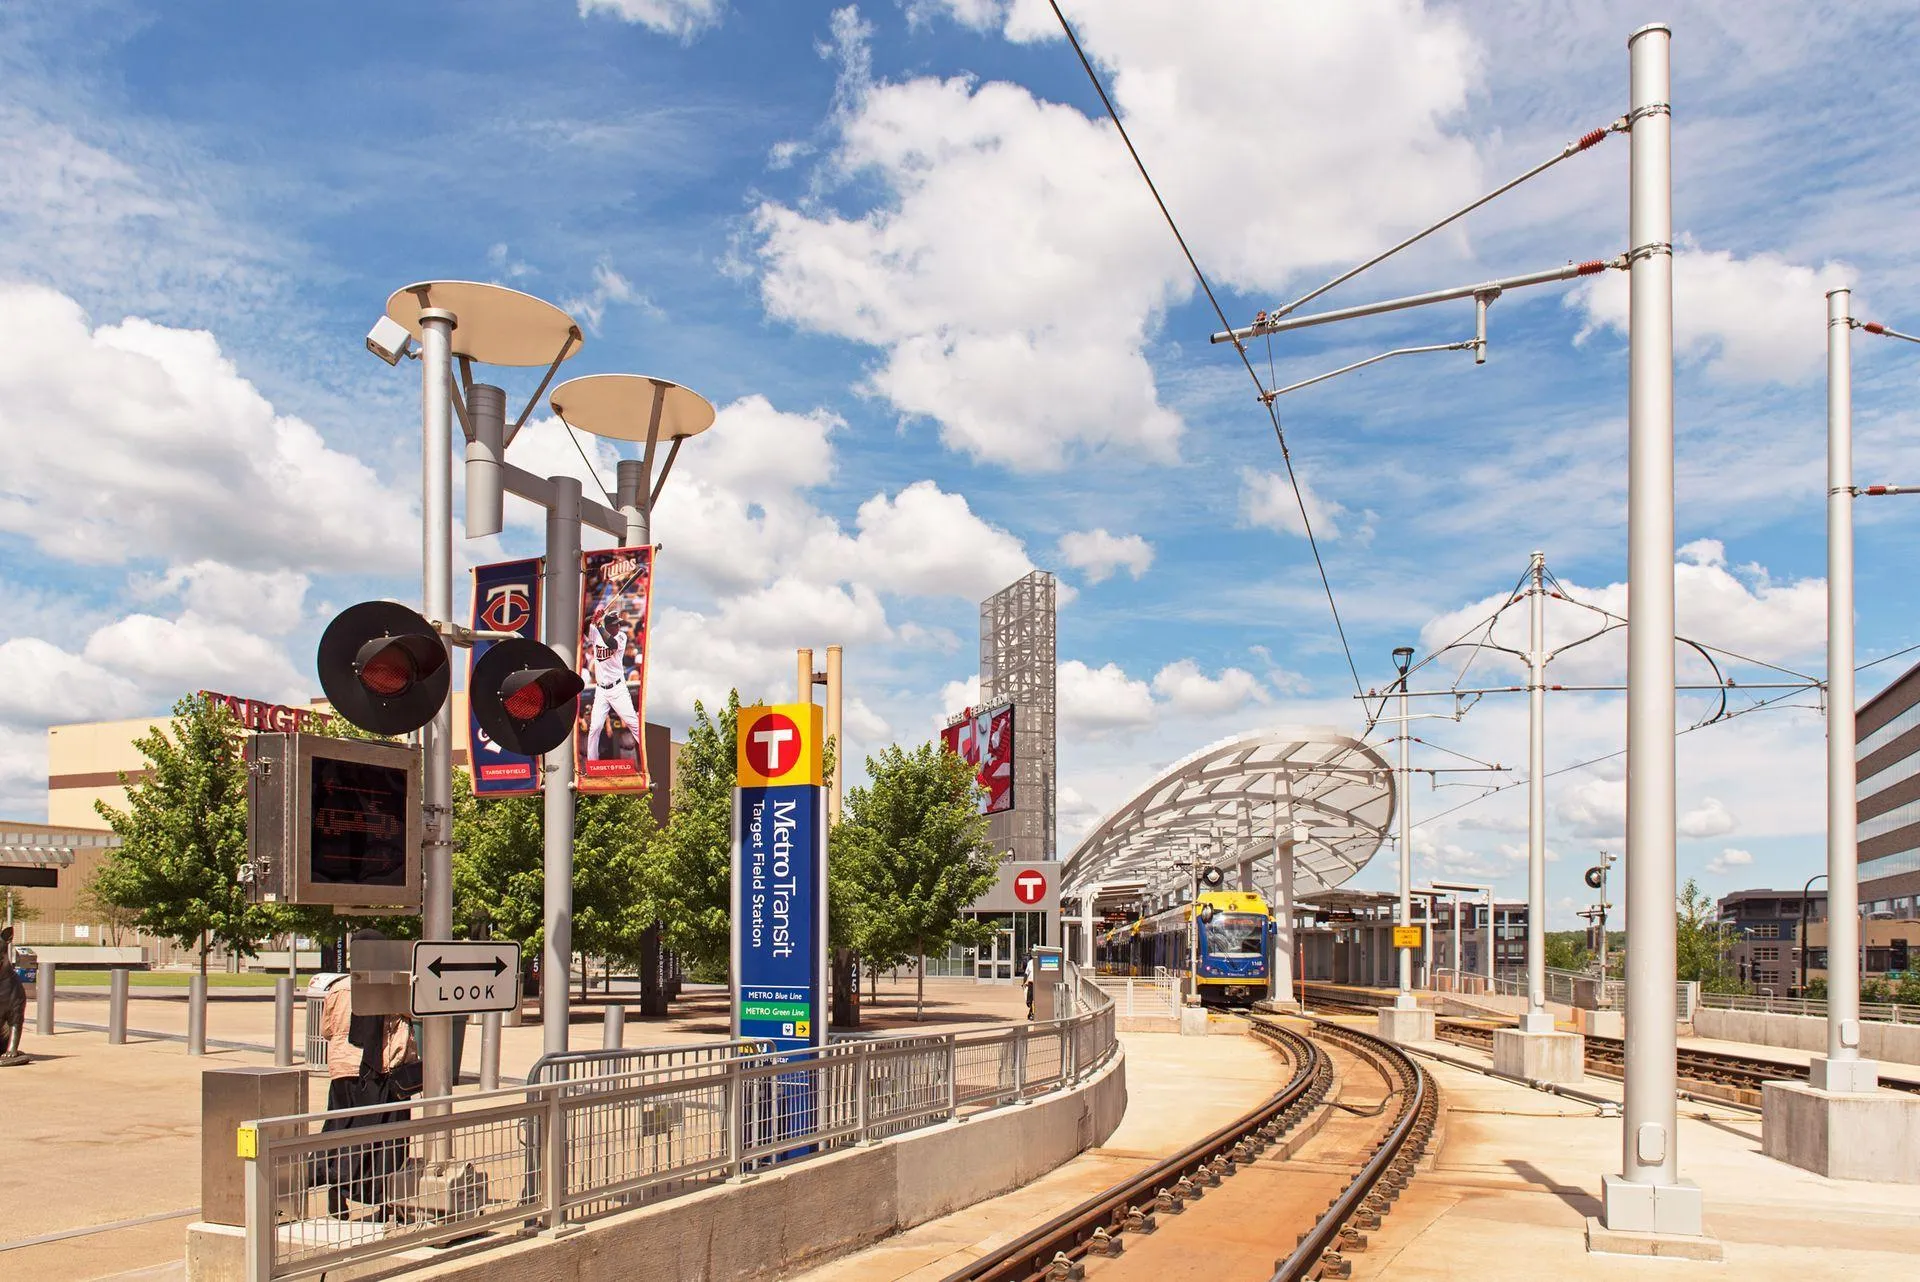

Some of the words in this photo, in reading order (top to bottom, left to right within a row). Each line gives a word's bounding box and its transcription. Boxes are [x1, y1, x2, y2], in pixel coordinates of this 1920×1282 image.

[600, 558, 637, 581] Twins
[754, 729, 793, 769] T
[750, 801, 765, 848] Target
[752, 853, 765, 889] Field
[1018, 877, 1042, 900] T
[752, 894, 765, 948] Station
[439, 985, 495, 1001] LOOK
[748, 991, 773, 999] METRO
[775, 992, 788, 1000] Blue
[789, 993, 803, 1001] Line
[745, 1007, 771, 1015] METRO
[772, 1008, 791, 1016] Green
[792, 1009, 805, 1017] Line
